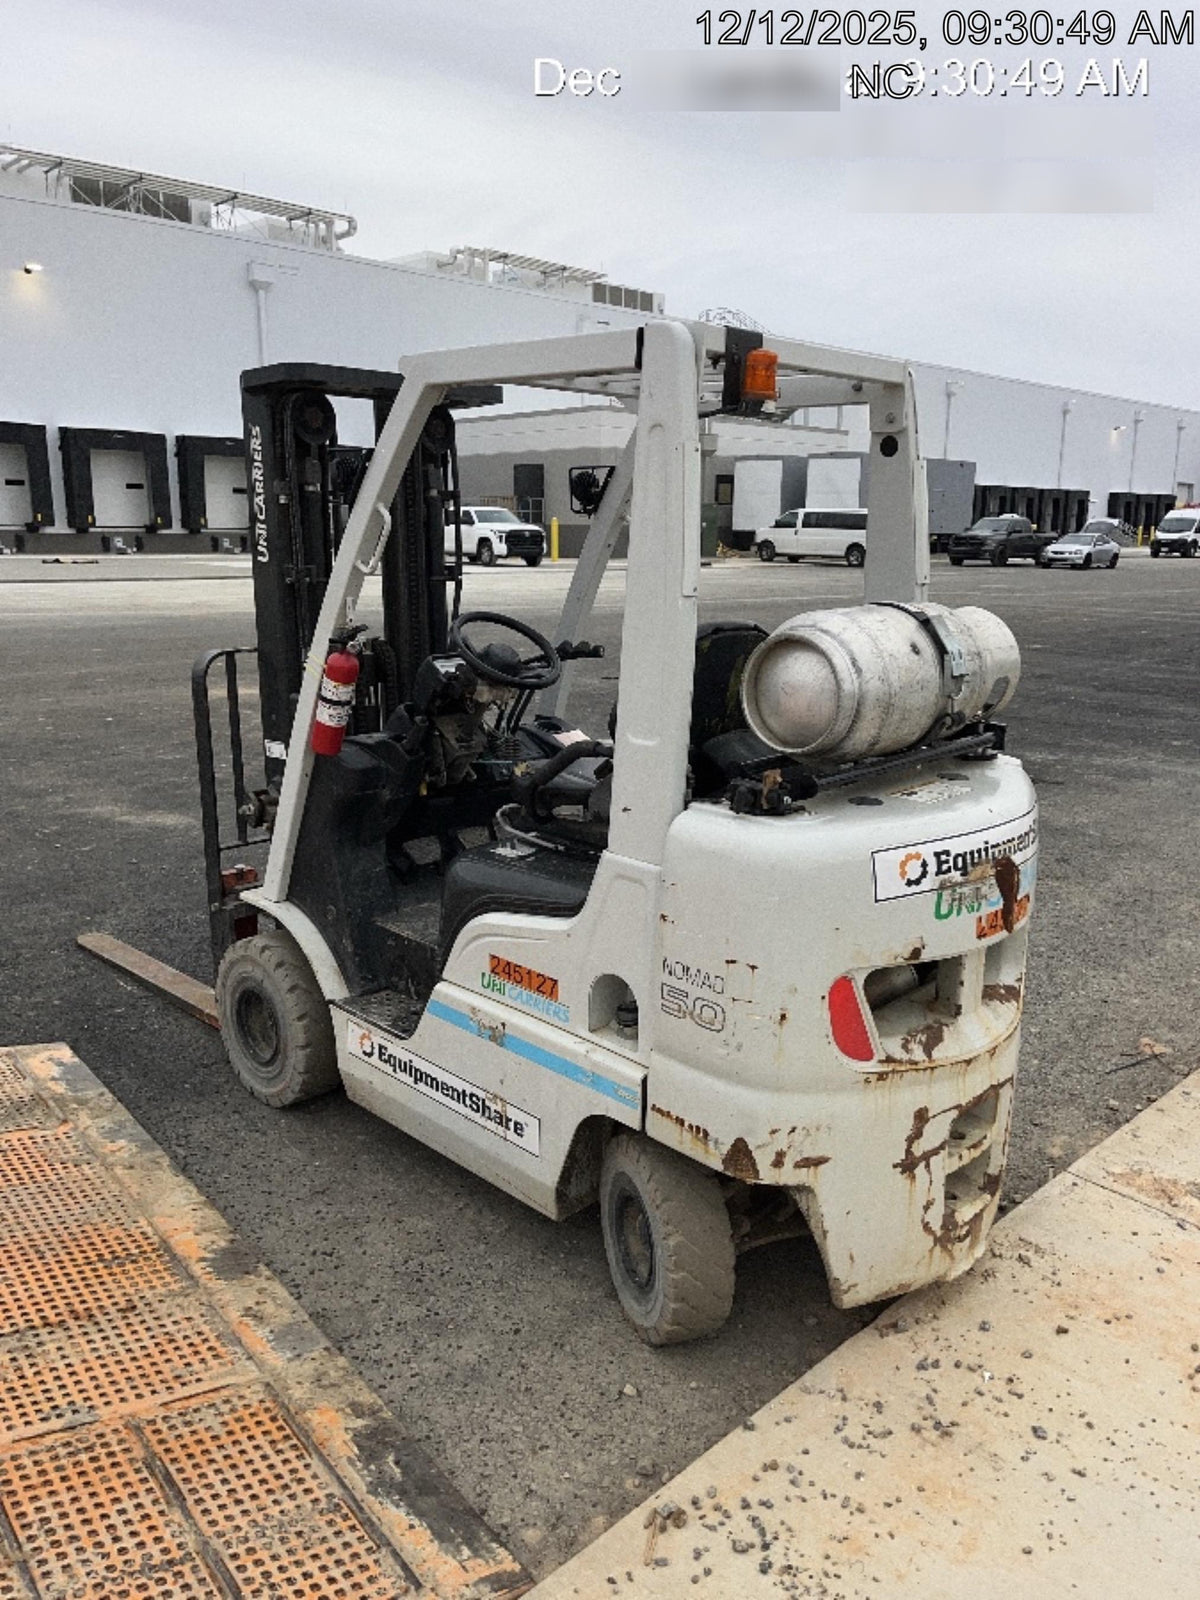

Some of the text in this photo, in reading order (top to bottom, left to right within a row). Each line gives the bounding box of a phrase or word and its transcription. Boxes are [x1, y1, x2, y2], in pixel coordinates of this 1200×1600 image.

[489, 954, 559, 1000] 245127
[661, 956, 725, 995] NOMAD
[660, 981, 726, 1034] 50
[378, 1042, 527, 1139] EquipmentShare
